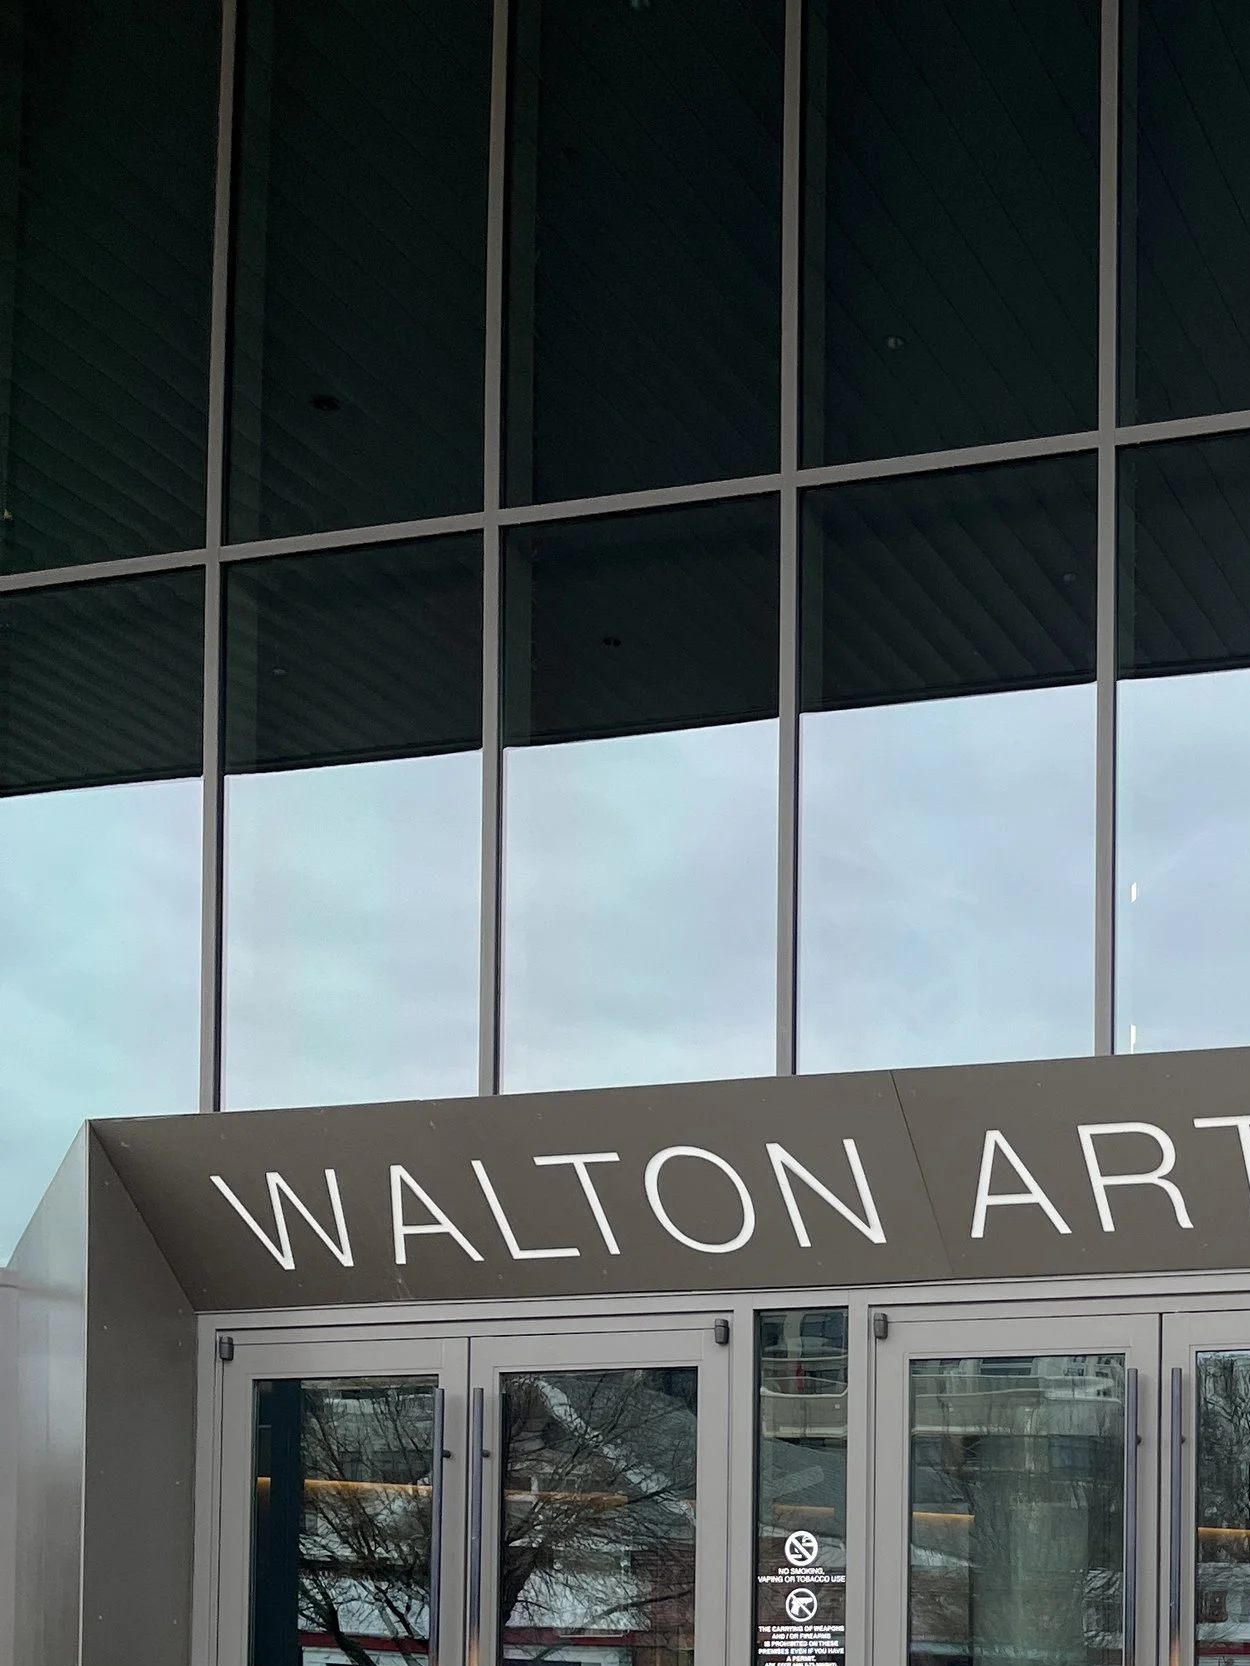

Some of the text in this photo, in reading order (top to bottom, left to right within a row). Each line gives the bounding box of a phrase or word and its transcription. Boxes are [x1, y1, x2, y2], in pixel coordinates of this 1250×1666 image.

[210, 1138, 888, 1270] WALTON
[778, 1567, 789, 1575] NO
[757, 1575, 846, 1583] VAPING OR TOBACCO USE
